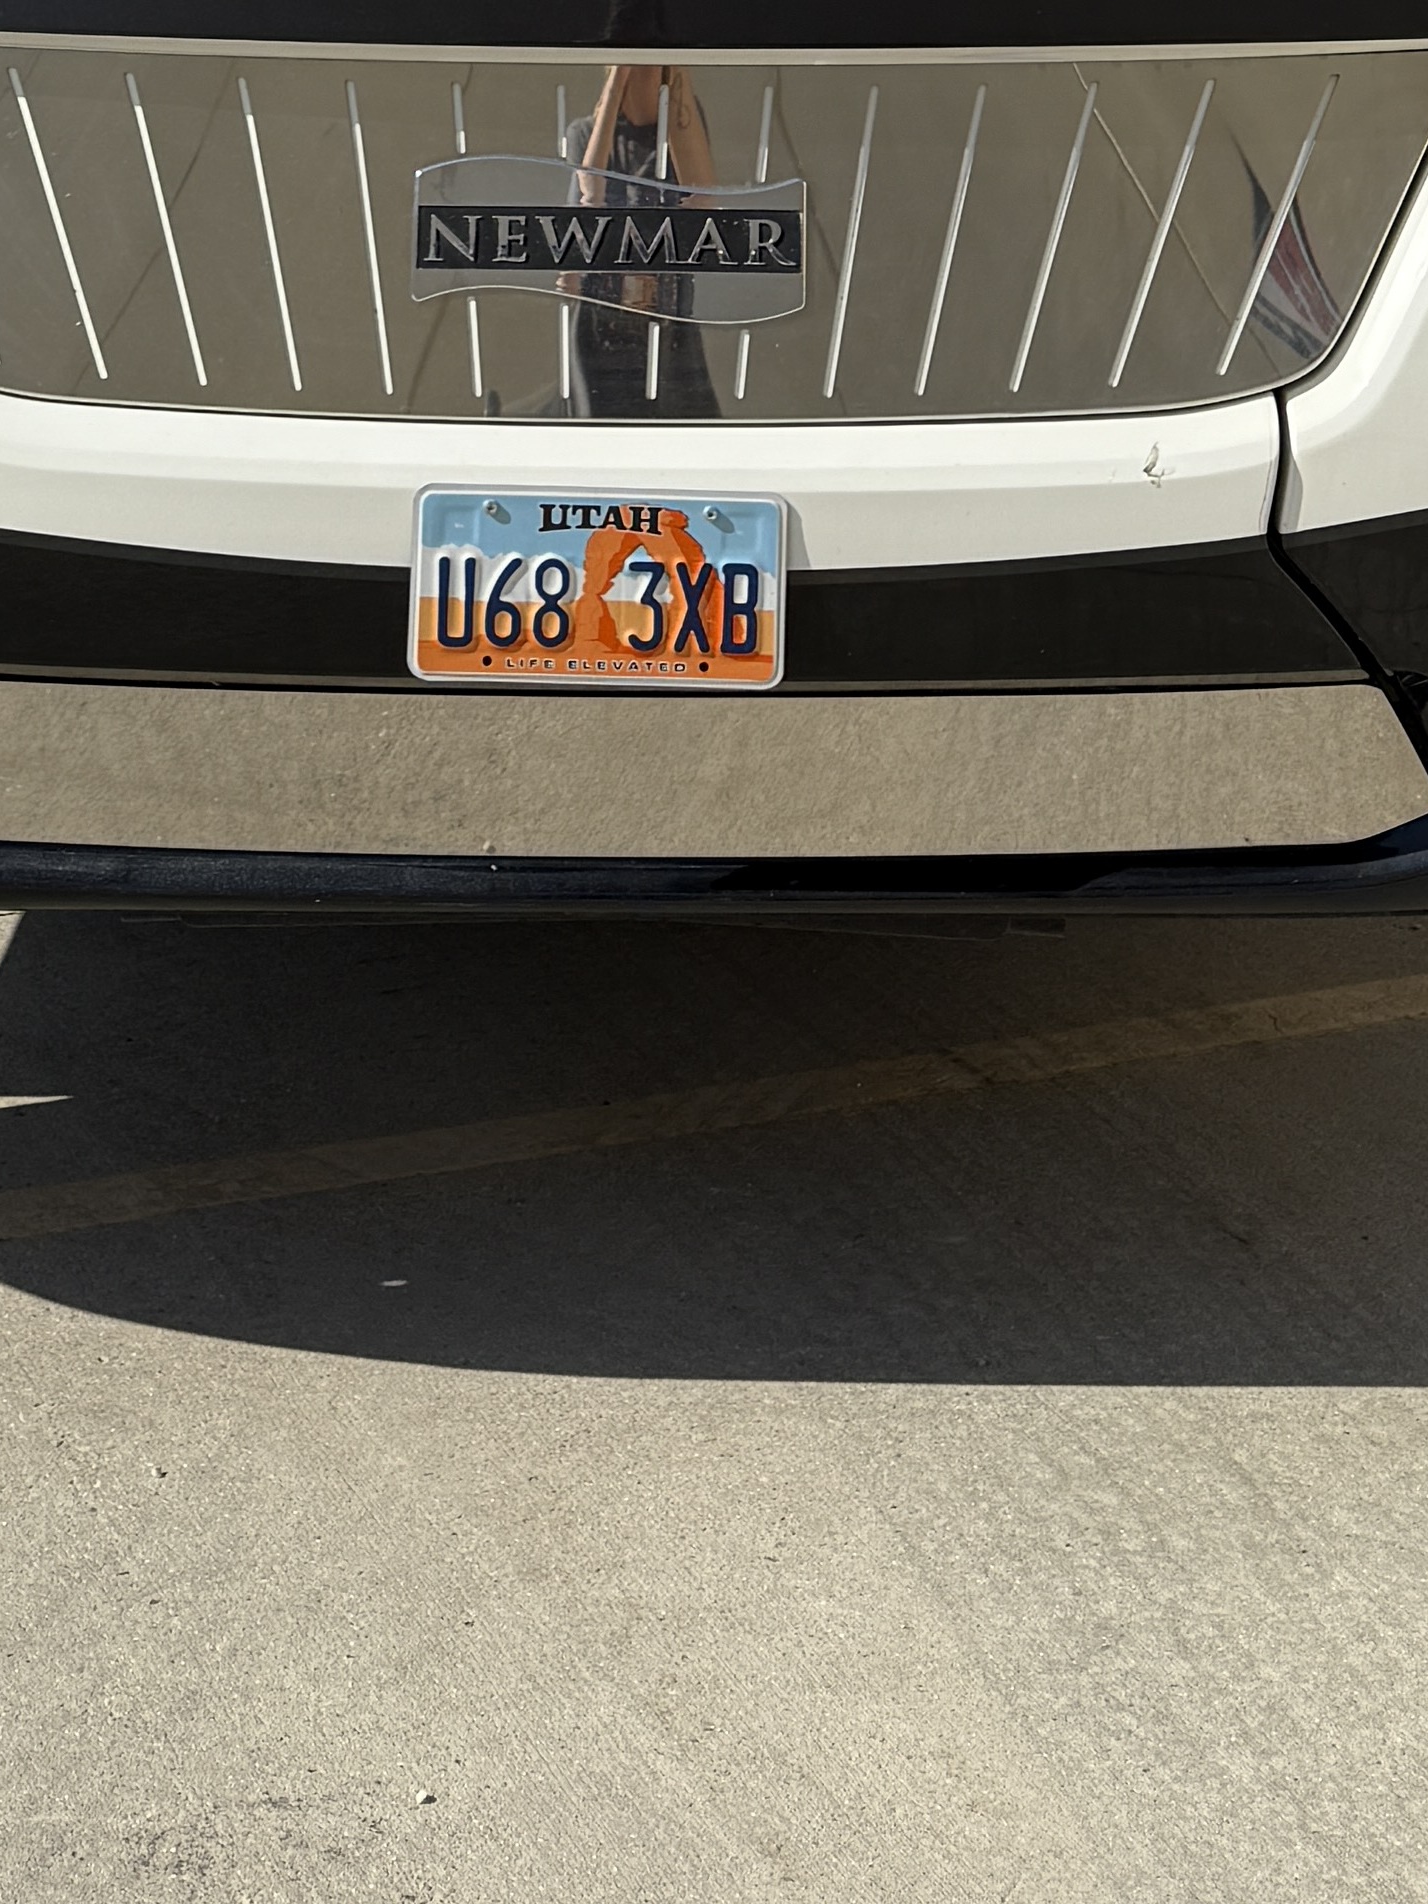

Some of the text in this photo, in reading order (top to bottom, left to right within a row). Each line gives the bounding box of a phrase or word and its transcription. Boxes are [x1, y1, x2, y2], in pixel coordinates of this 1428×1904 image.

[422, 213, 797, 267] NEWMAR
[538, 503, 664, 535] UTAH
[437, 555, 760, 655] U68 3XB
[506, 658, 686, 673] LIFE ELEVATED
